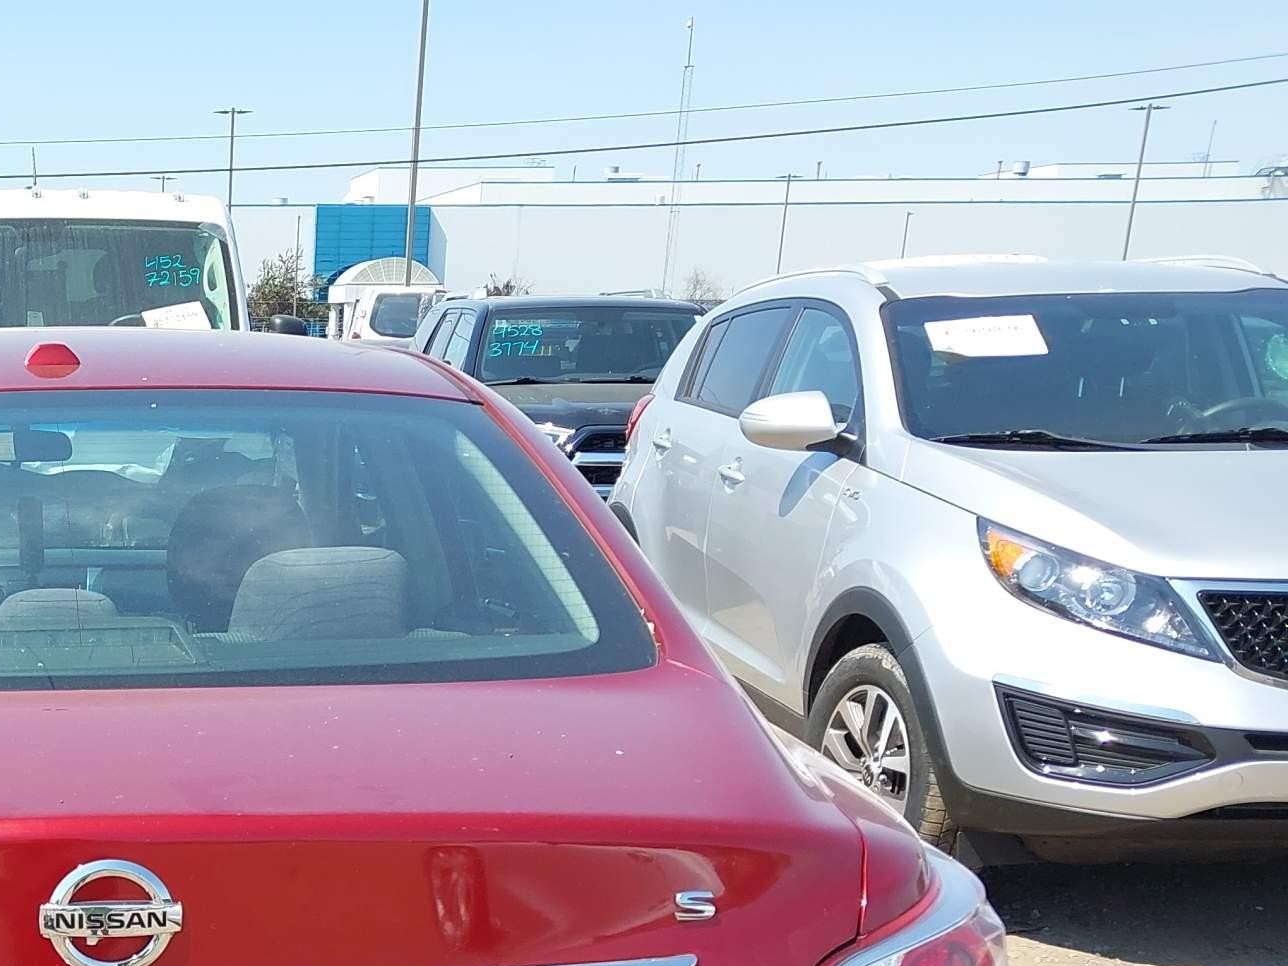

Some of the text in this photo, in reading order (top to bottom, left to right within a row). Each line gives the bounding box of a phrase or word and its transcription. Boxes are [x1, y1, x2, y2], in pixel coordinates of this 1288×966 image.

[145, 254, 186, 270] 452
[145, 267, 200, 287] 72159
[493, 324, 543, 338] 4528
[490, 340, 540, 357] 3774
[674, 890, 717, 921] S
[55, 911, 168, 930] NISSAN
